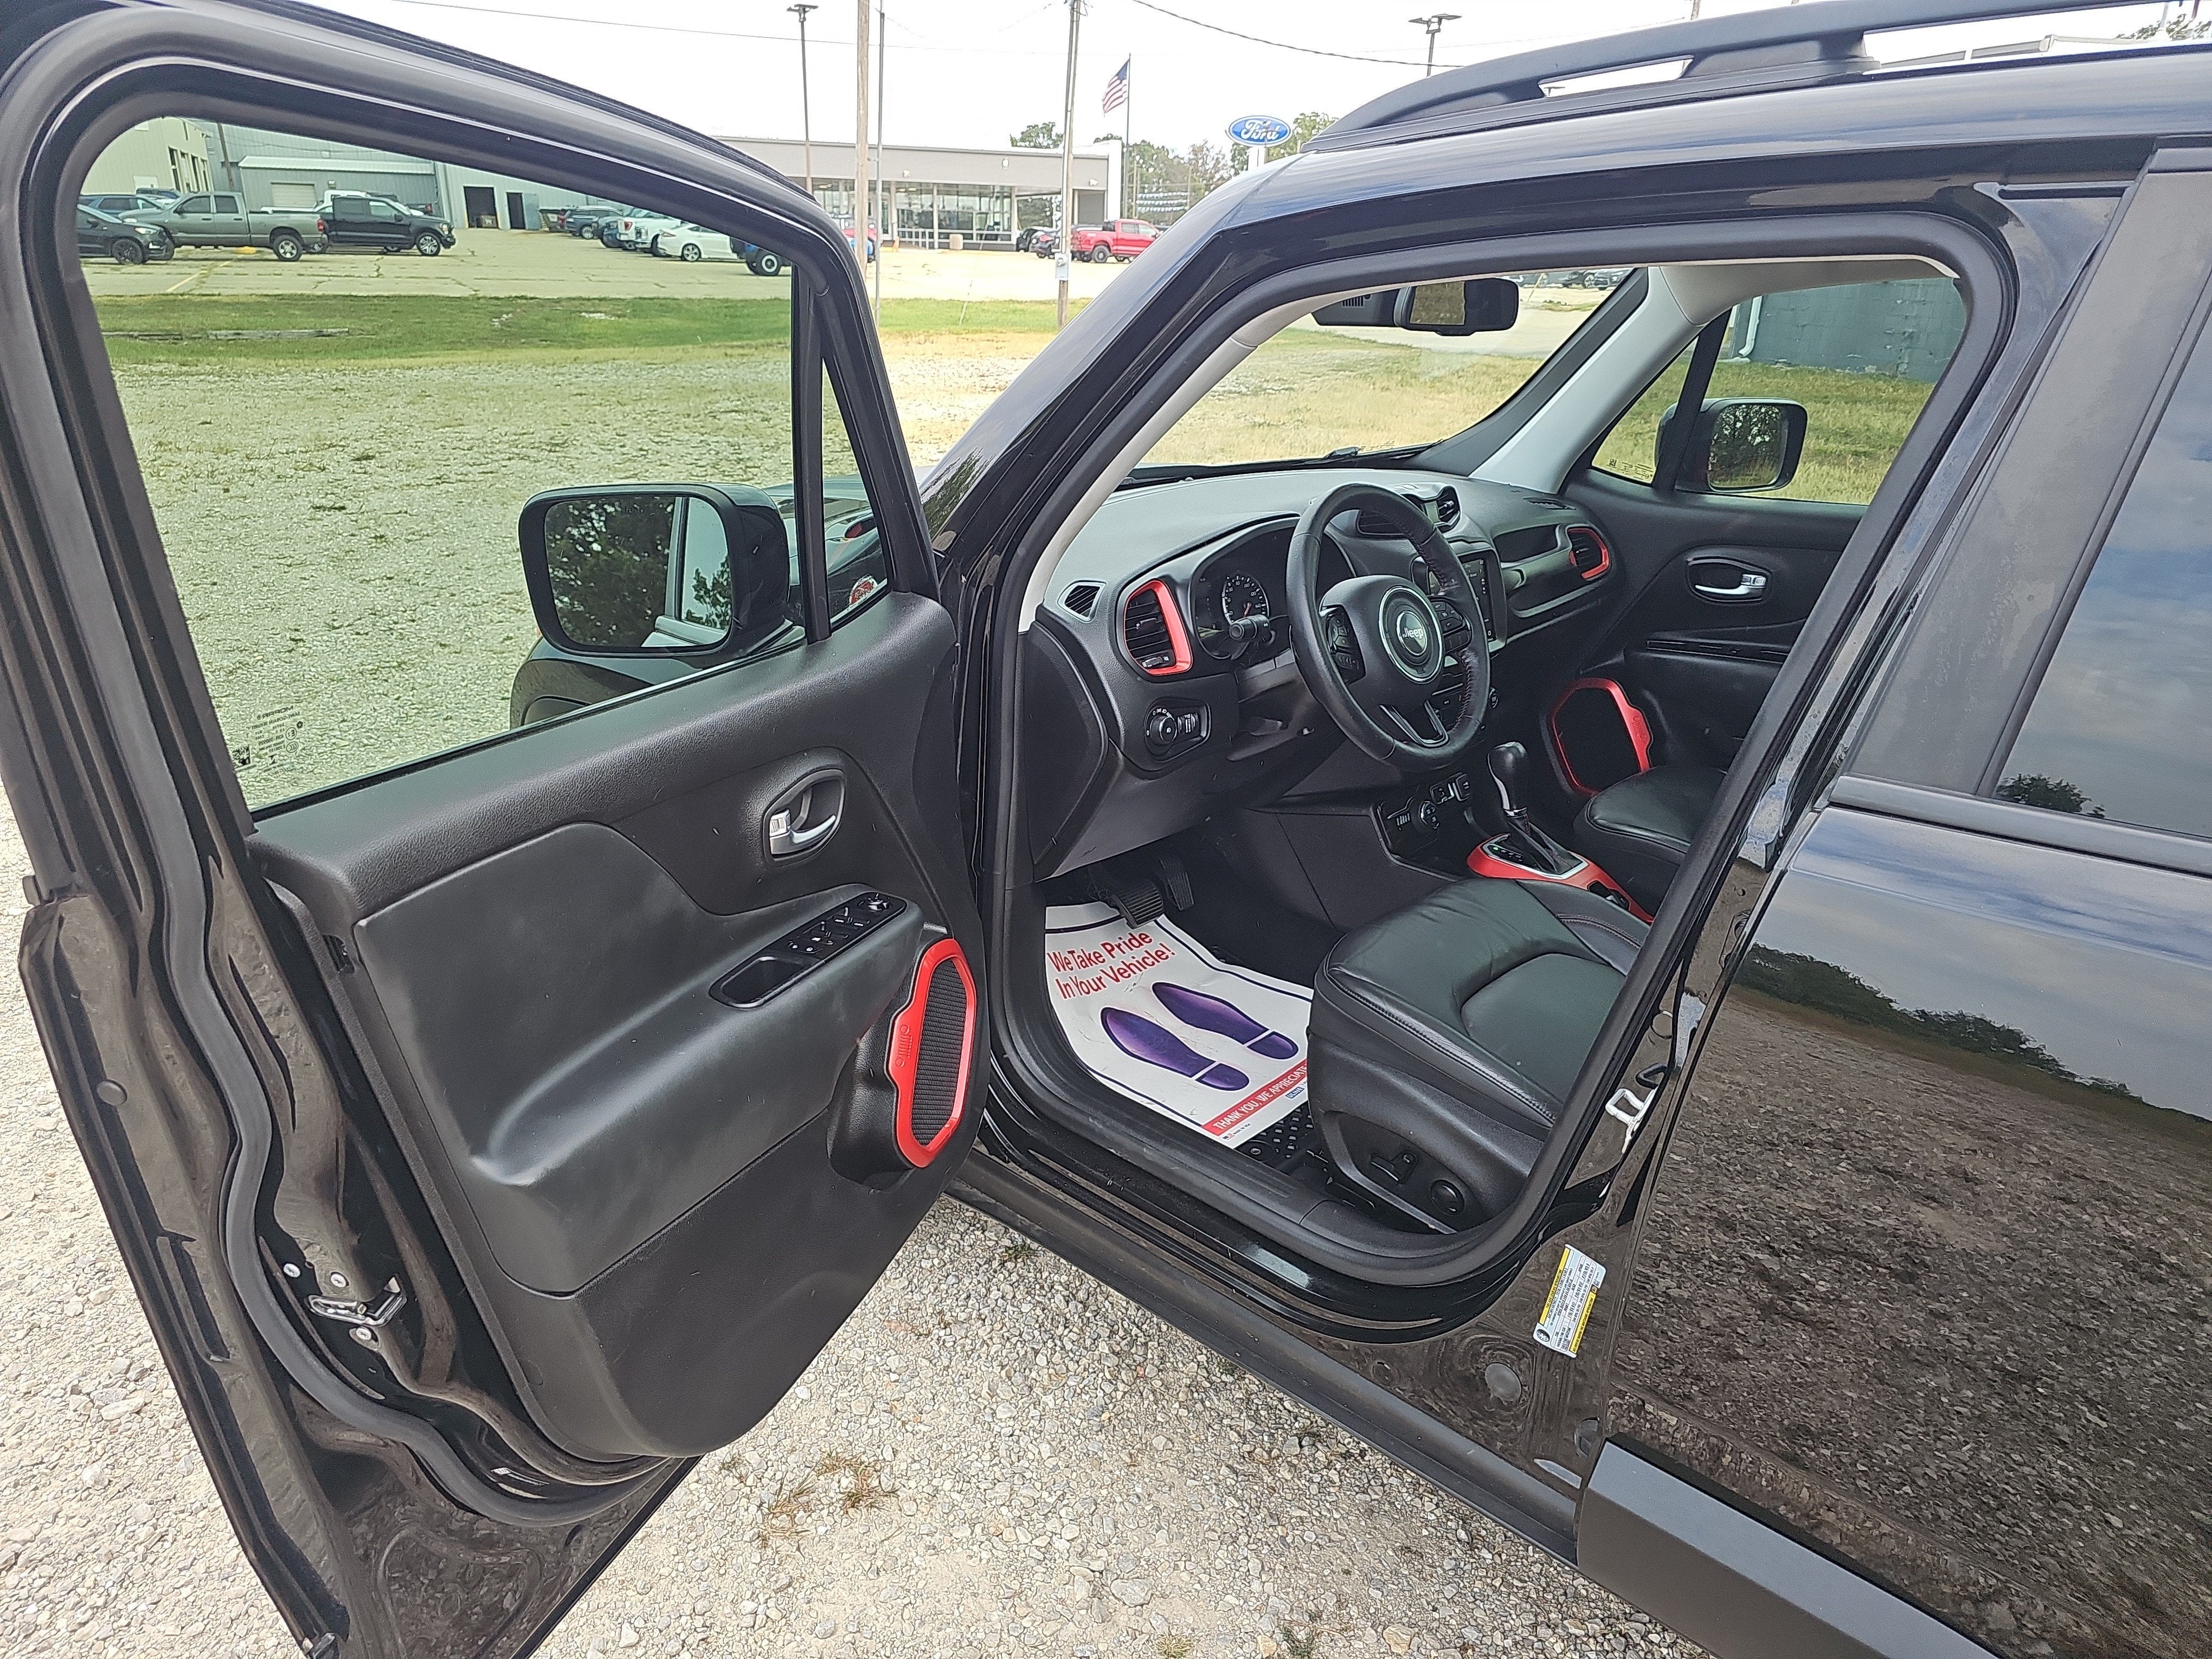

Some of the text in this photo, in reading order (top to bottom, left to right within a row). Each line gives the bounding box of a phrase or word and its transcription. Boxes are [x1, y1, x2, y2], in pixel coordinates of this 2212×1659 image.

[1241, 119, 1281, 140] Ford
[1402, 627, 1424, 640] Jeep
[1046, 932, 1153, 972] We Take Pride
[1055, 942, 1176, 999] In Your Vehicle!
[1212, 1109, 1243, 1130] THANK
[1240, 1099, 1263, 1114] YOU,
[1255, 1090, 1274, 1102] WE
